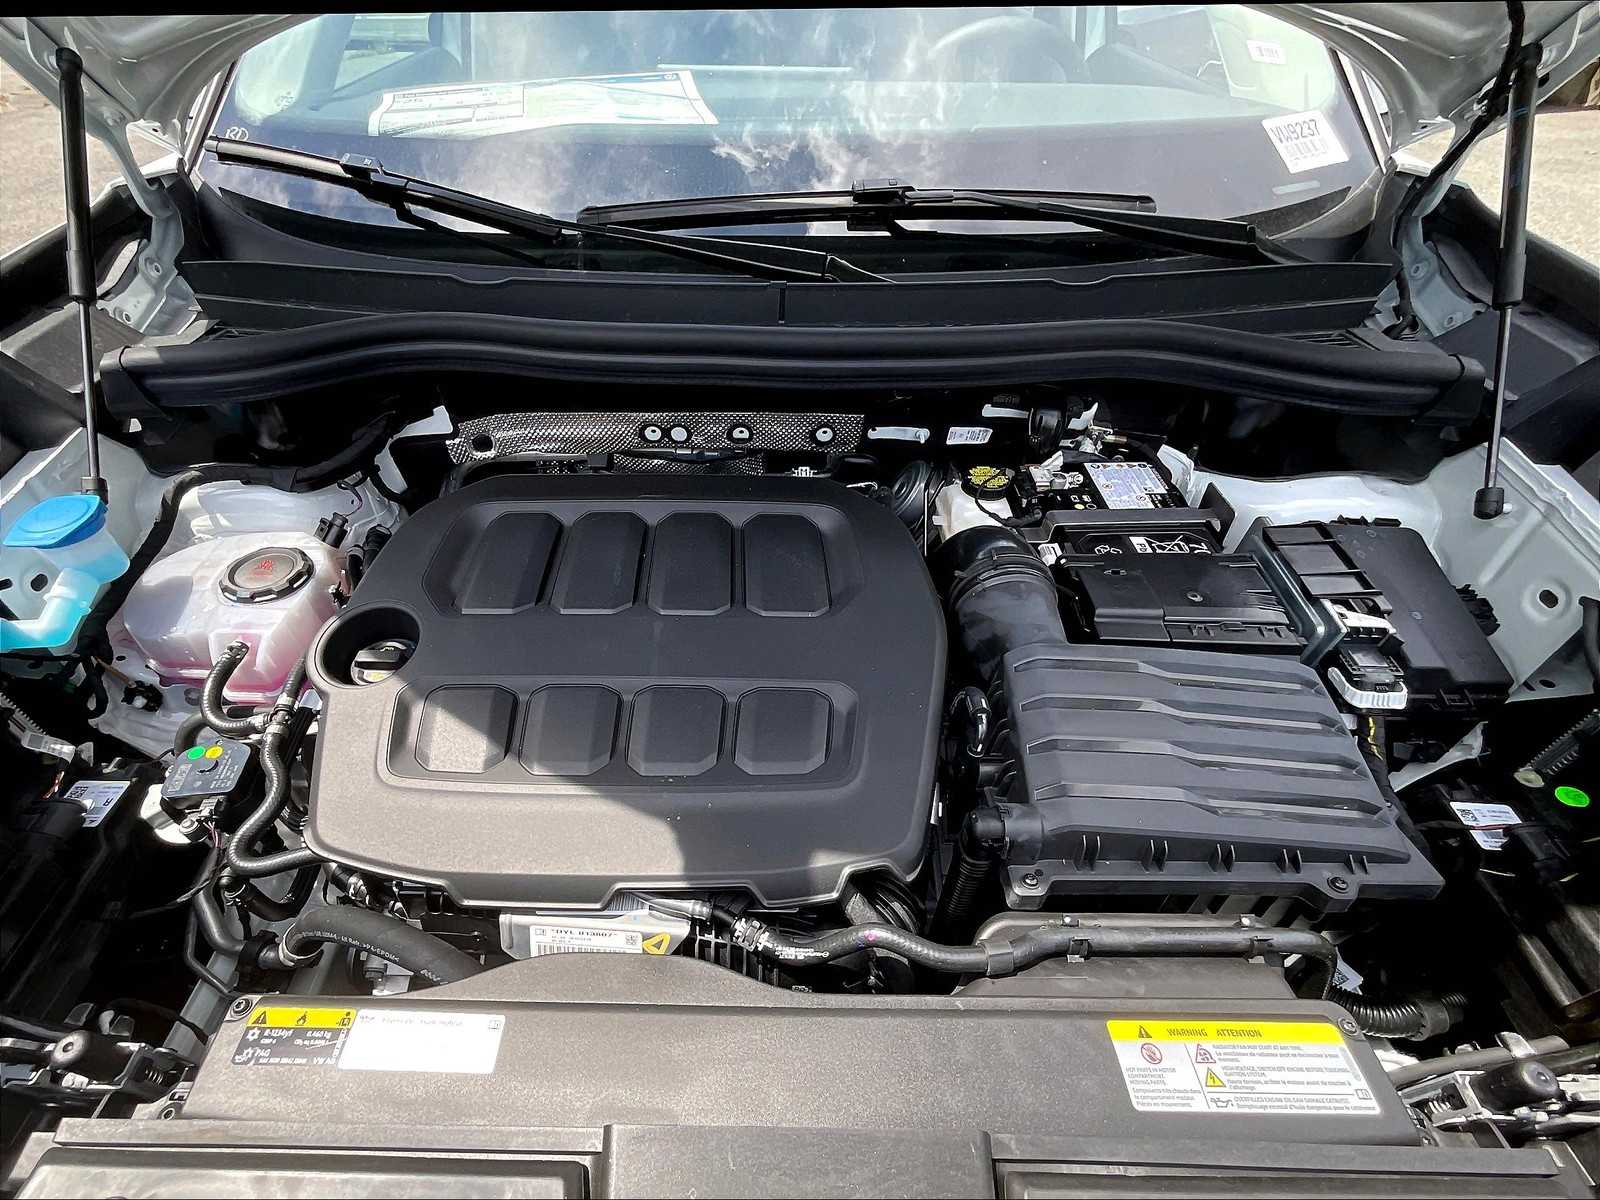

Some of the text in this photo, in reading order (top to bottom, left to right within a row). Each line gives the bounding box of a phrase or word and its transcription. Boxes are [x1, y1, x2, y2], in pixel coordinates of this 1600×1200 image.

[1270, 118, 1321, 144] VW9237
[1167, 1028, 1263, 1039] WARNING ATTENTION
